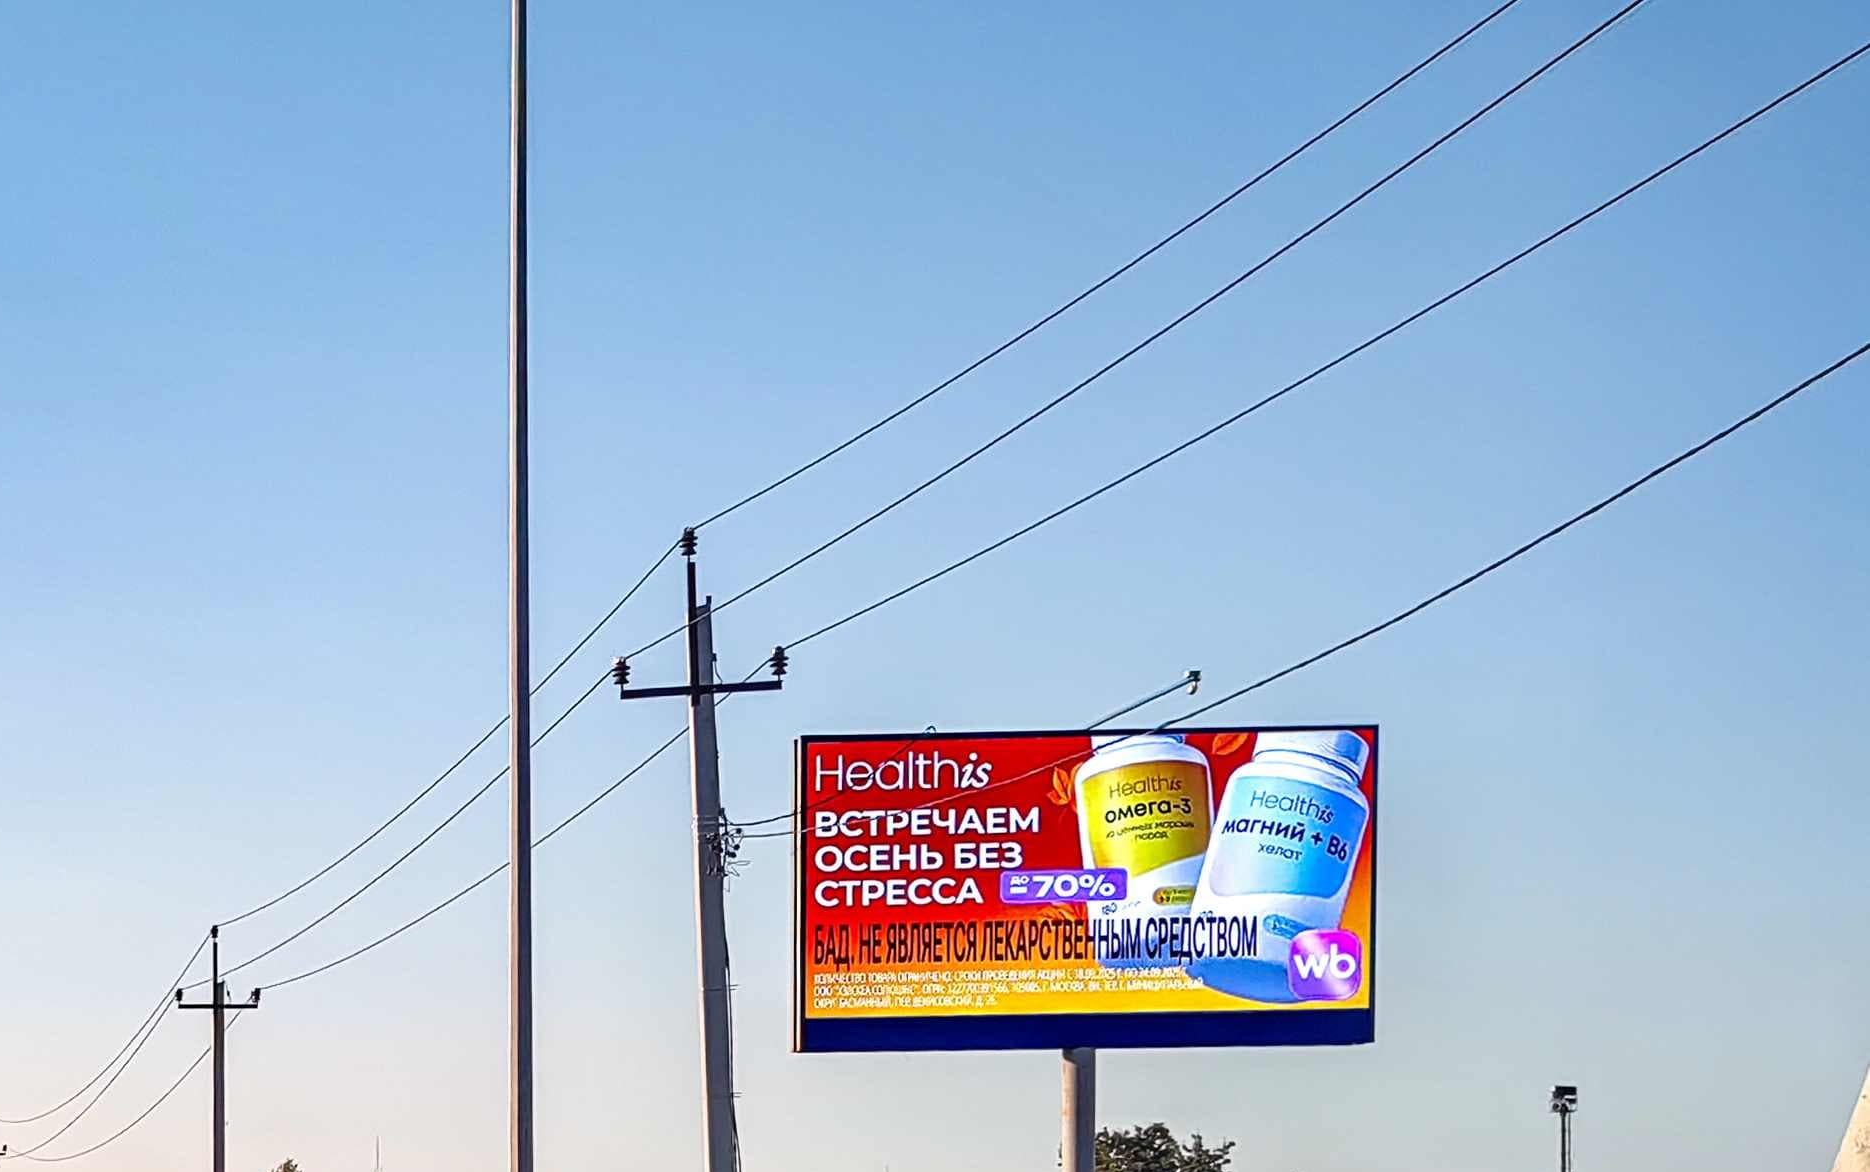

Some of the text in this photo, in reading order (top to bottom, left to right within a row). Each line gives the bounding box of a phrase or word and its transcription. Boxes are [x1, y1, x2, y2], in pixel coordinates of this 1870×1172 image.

[815, 751, 992, 791] Healthis
[1109, 775, 1182, 798] Healthis
[815, 807, 1040, 837] ВСТРЕЧАЕМ
[1105, 798, 1192, 823] омега-3
[1250, 790, 1335, 825] Healthis
[1221, 817, 1305, 843] магний
[814, 841, 1023, 872] ОСЕНЬ БЕЗ
[1258, 842, 1303, 861] хелат
[814, 878, 984, 906] СТРЕССА
[814, 923, 855, 971] БАД.
[859, 923, 882, 963] НЕ
[886, 920, 977, 964] ЯВЛЯЕТСЯ
[981, 917, 1141, 962] ЛЕКАРСТВЕННЫМ
[1146, 915, 1257, 965] СРЕДСТВОМ
[1293, 943, 1356, 980] wb
